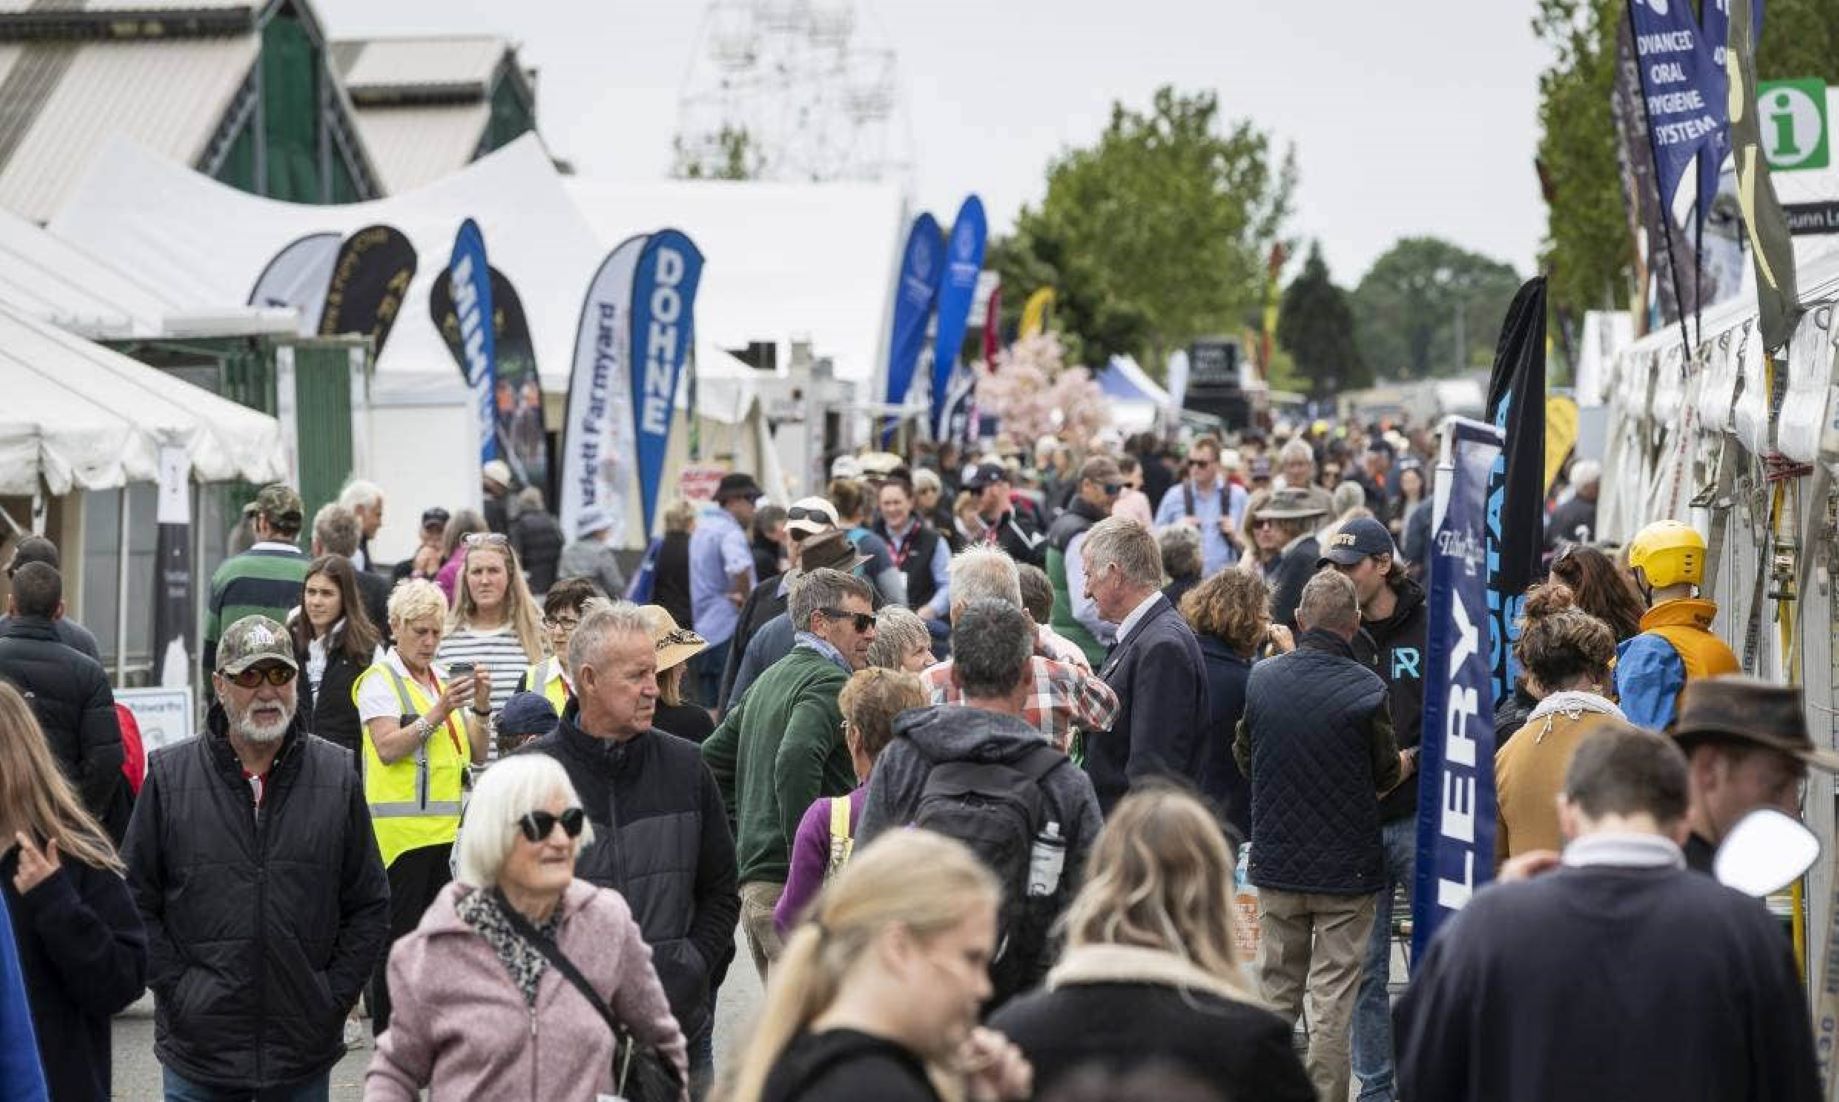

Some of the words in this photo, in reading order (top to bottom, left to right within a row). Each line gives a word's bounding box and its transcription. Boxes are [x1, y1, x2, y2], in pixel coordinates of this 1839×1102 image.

[1650, 62, 1687, 84] ORAL
[1786, 209, 1825, 229] unn
[583, 302, 616, 434] Farmyard
[641, 247, 684, 436] DOHNE
